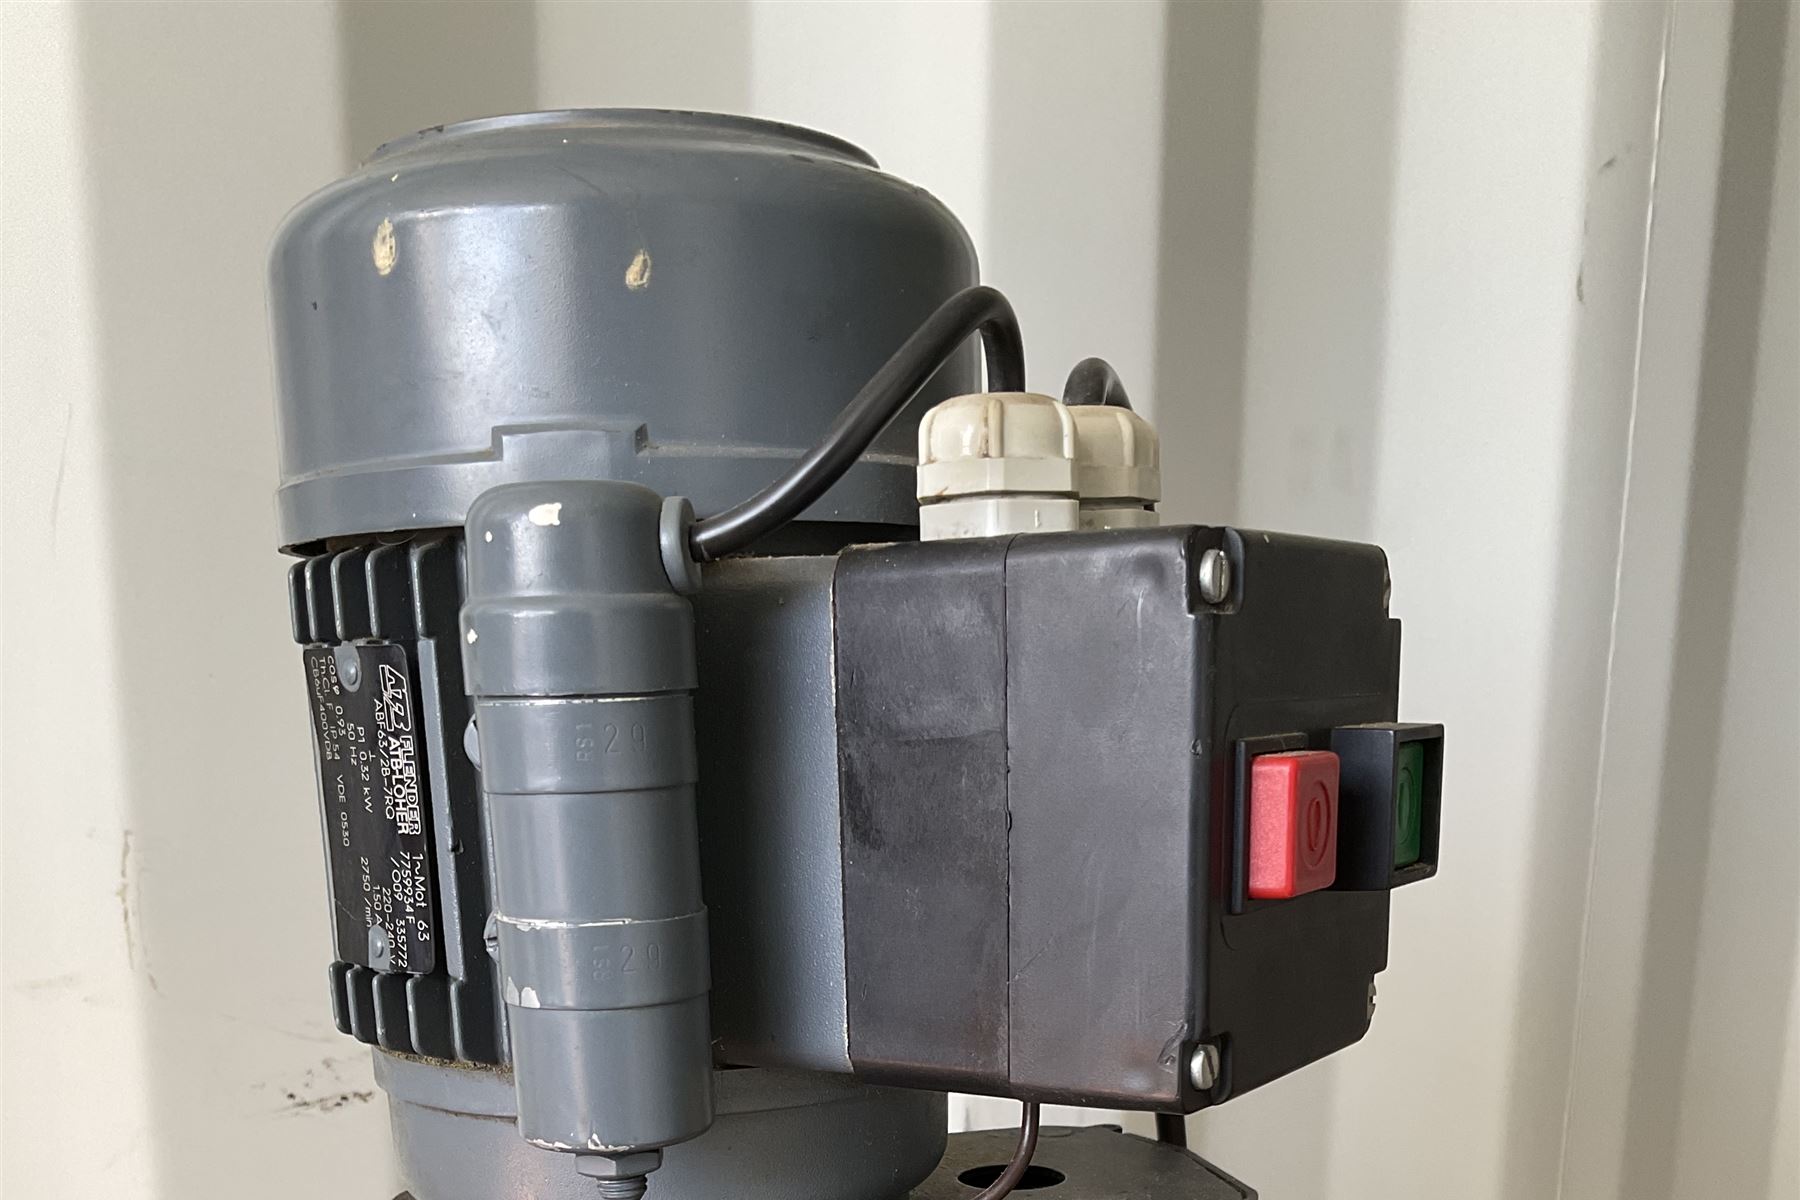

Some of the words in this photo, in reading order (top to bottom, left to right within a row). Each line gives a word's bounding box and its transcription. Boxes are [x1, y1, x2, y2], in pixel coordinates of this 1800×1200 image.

[326, 702, 334, 710] F
[330, 725, 337, 739] IP
[335, 706, 346, 736] 0.93
[346, 723, 356, 740] 50
[356, 726, 365, 742] P1
[332, 744, 340, 760] 54
[350, 746, 357, 766] Hz
[359, 751, 370, 781] 0.32
[336, 774, 346, 802] VDE
[388, 736, 409, 834] ATB-LOHER
[400, 735, 421, 835] FLENDER
[363, 787, 373, 813] kW
[340, 811, 350, 847] 0530
[360, 856, 371, 891] 2750
[400, 851, 414, 912] 7759934
[372, 884, 382, 911] 1.50
[374, 913, 383, 925] A
[417, 920, 430, 941] 63
[396, 918, 408, 968] 335772
